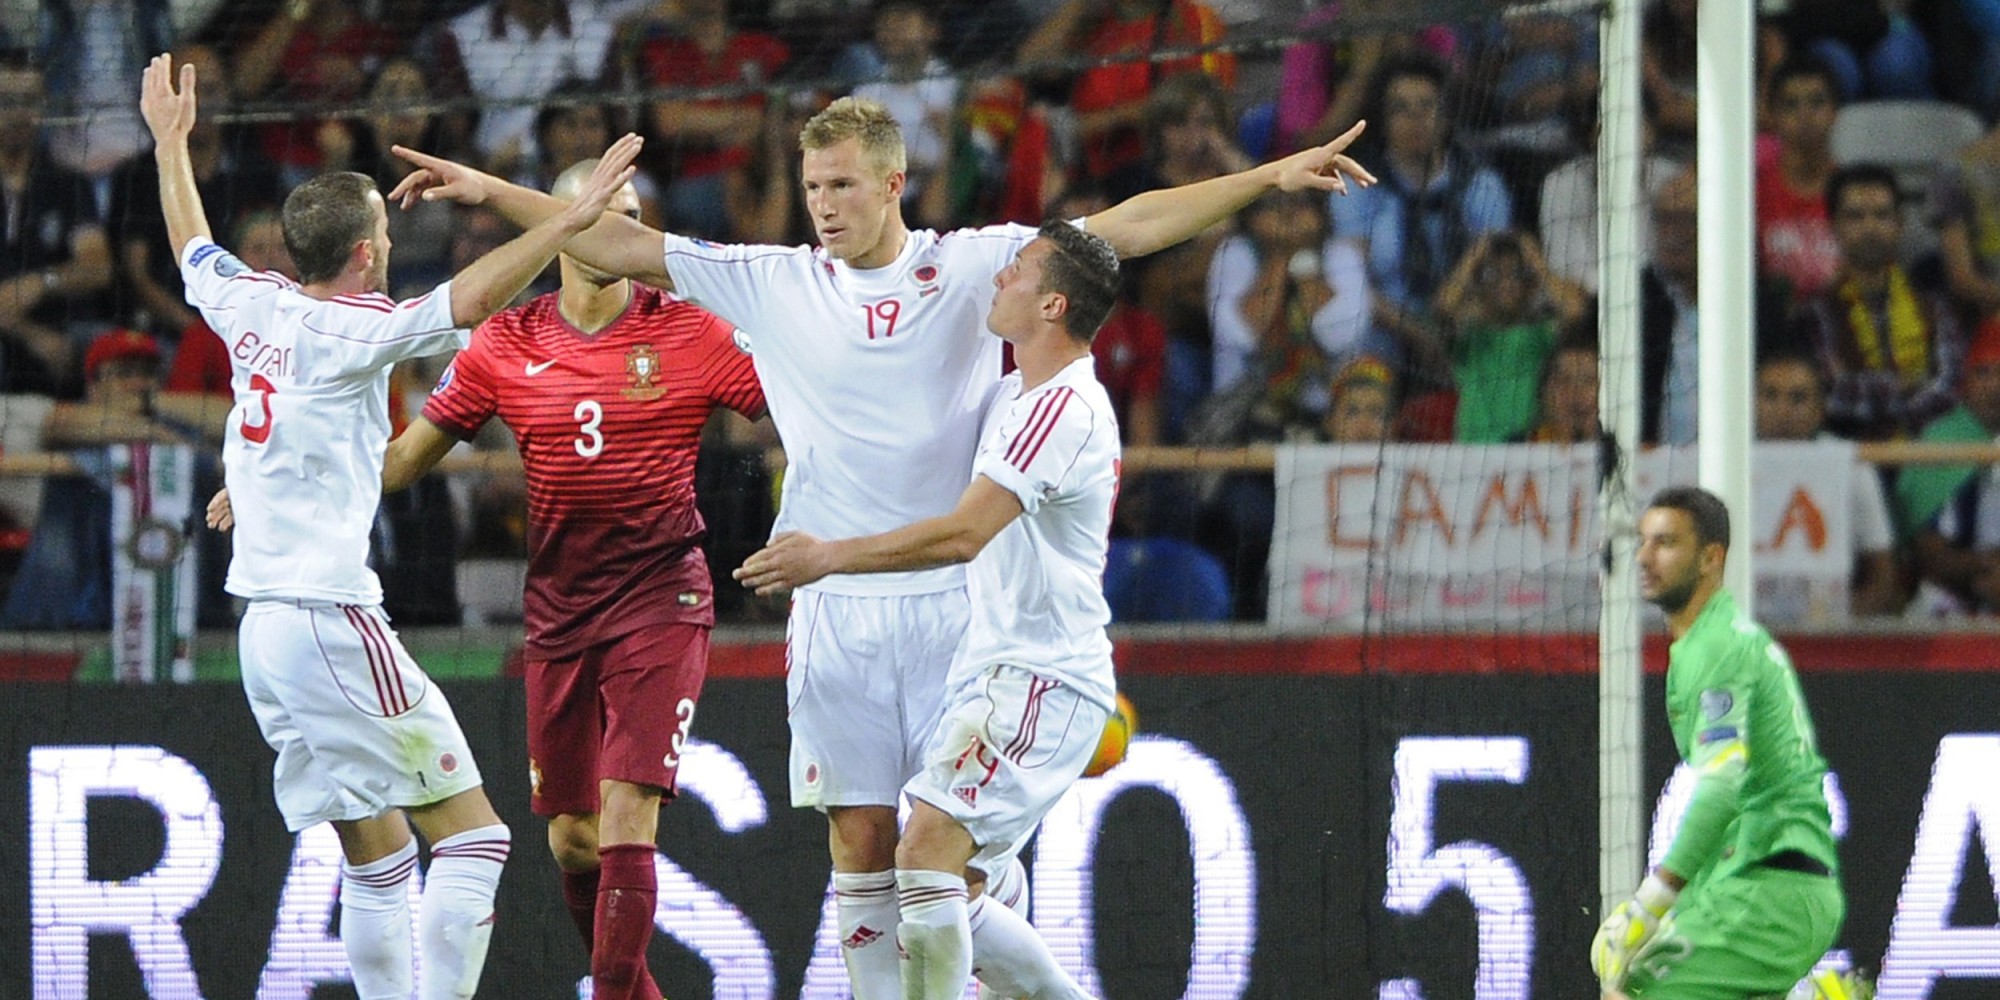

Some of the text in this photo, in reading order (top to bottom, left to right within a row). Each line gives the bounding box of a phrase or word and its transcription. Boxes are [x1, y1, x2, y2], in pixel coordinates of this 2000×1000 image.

[861, 299, 901, 340] 19
[573, 399, 604, 458] 3
[671, 697, 695, 756] 3
[1380, 736, 1536, 1000] 5
